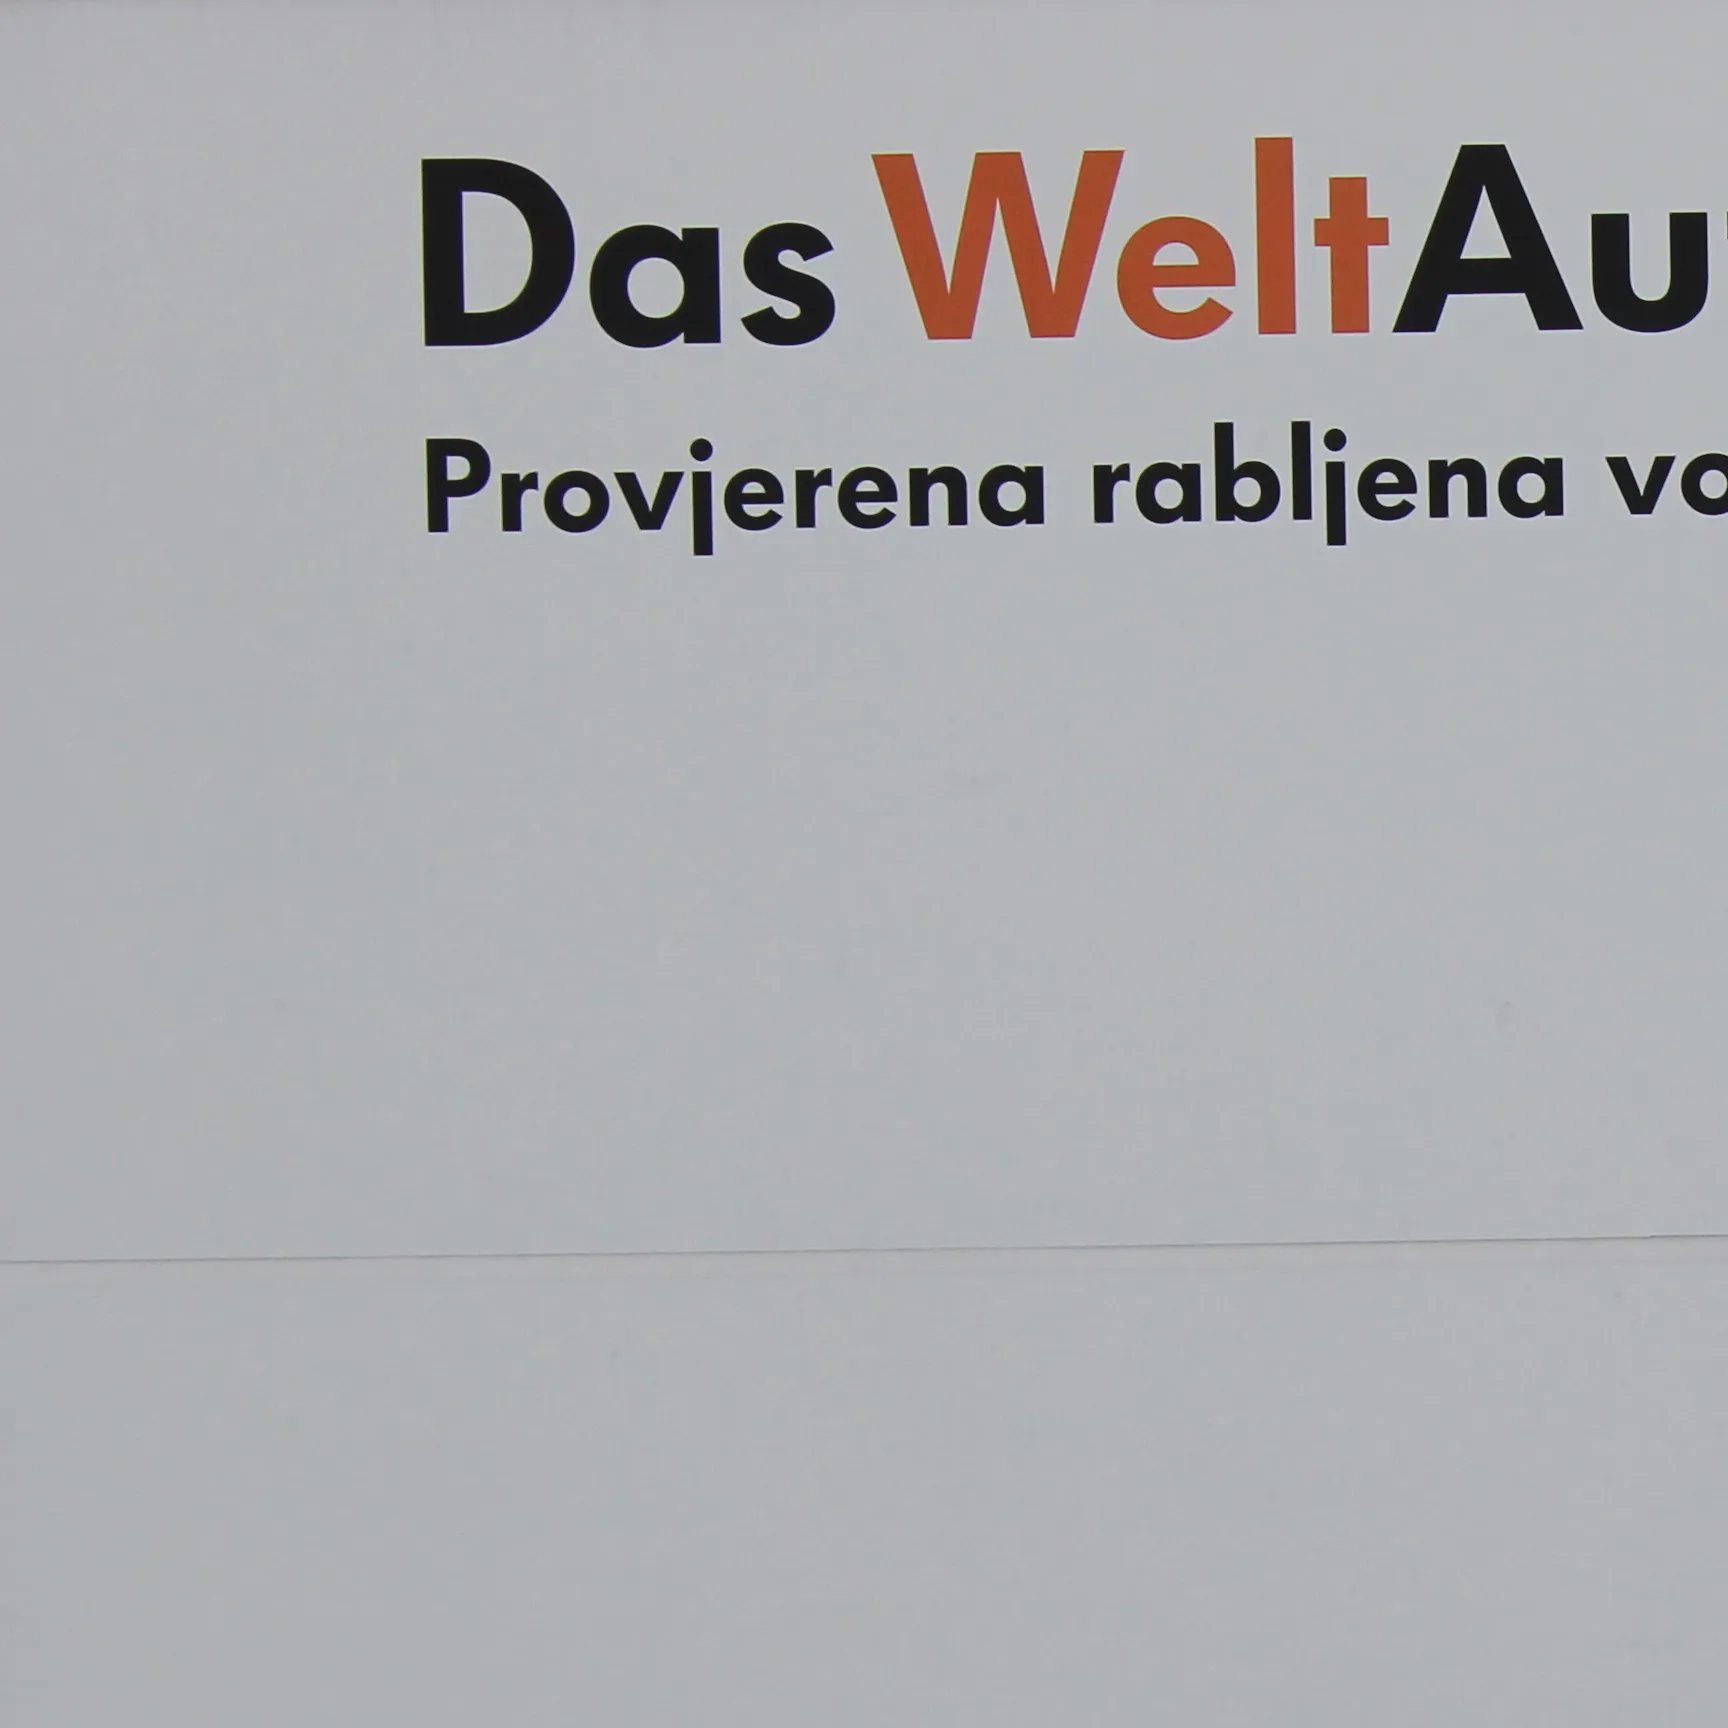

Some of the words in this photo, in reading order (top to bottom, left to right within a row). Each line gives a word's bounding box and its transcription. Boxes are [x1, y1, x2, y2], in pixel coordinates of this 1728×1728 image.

[421, 158, 836, 349] Das
[425, 438, 1045, 556] Provjerena
[1093, 420, 1564, 546] rabljena
